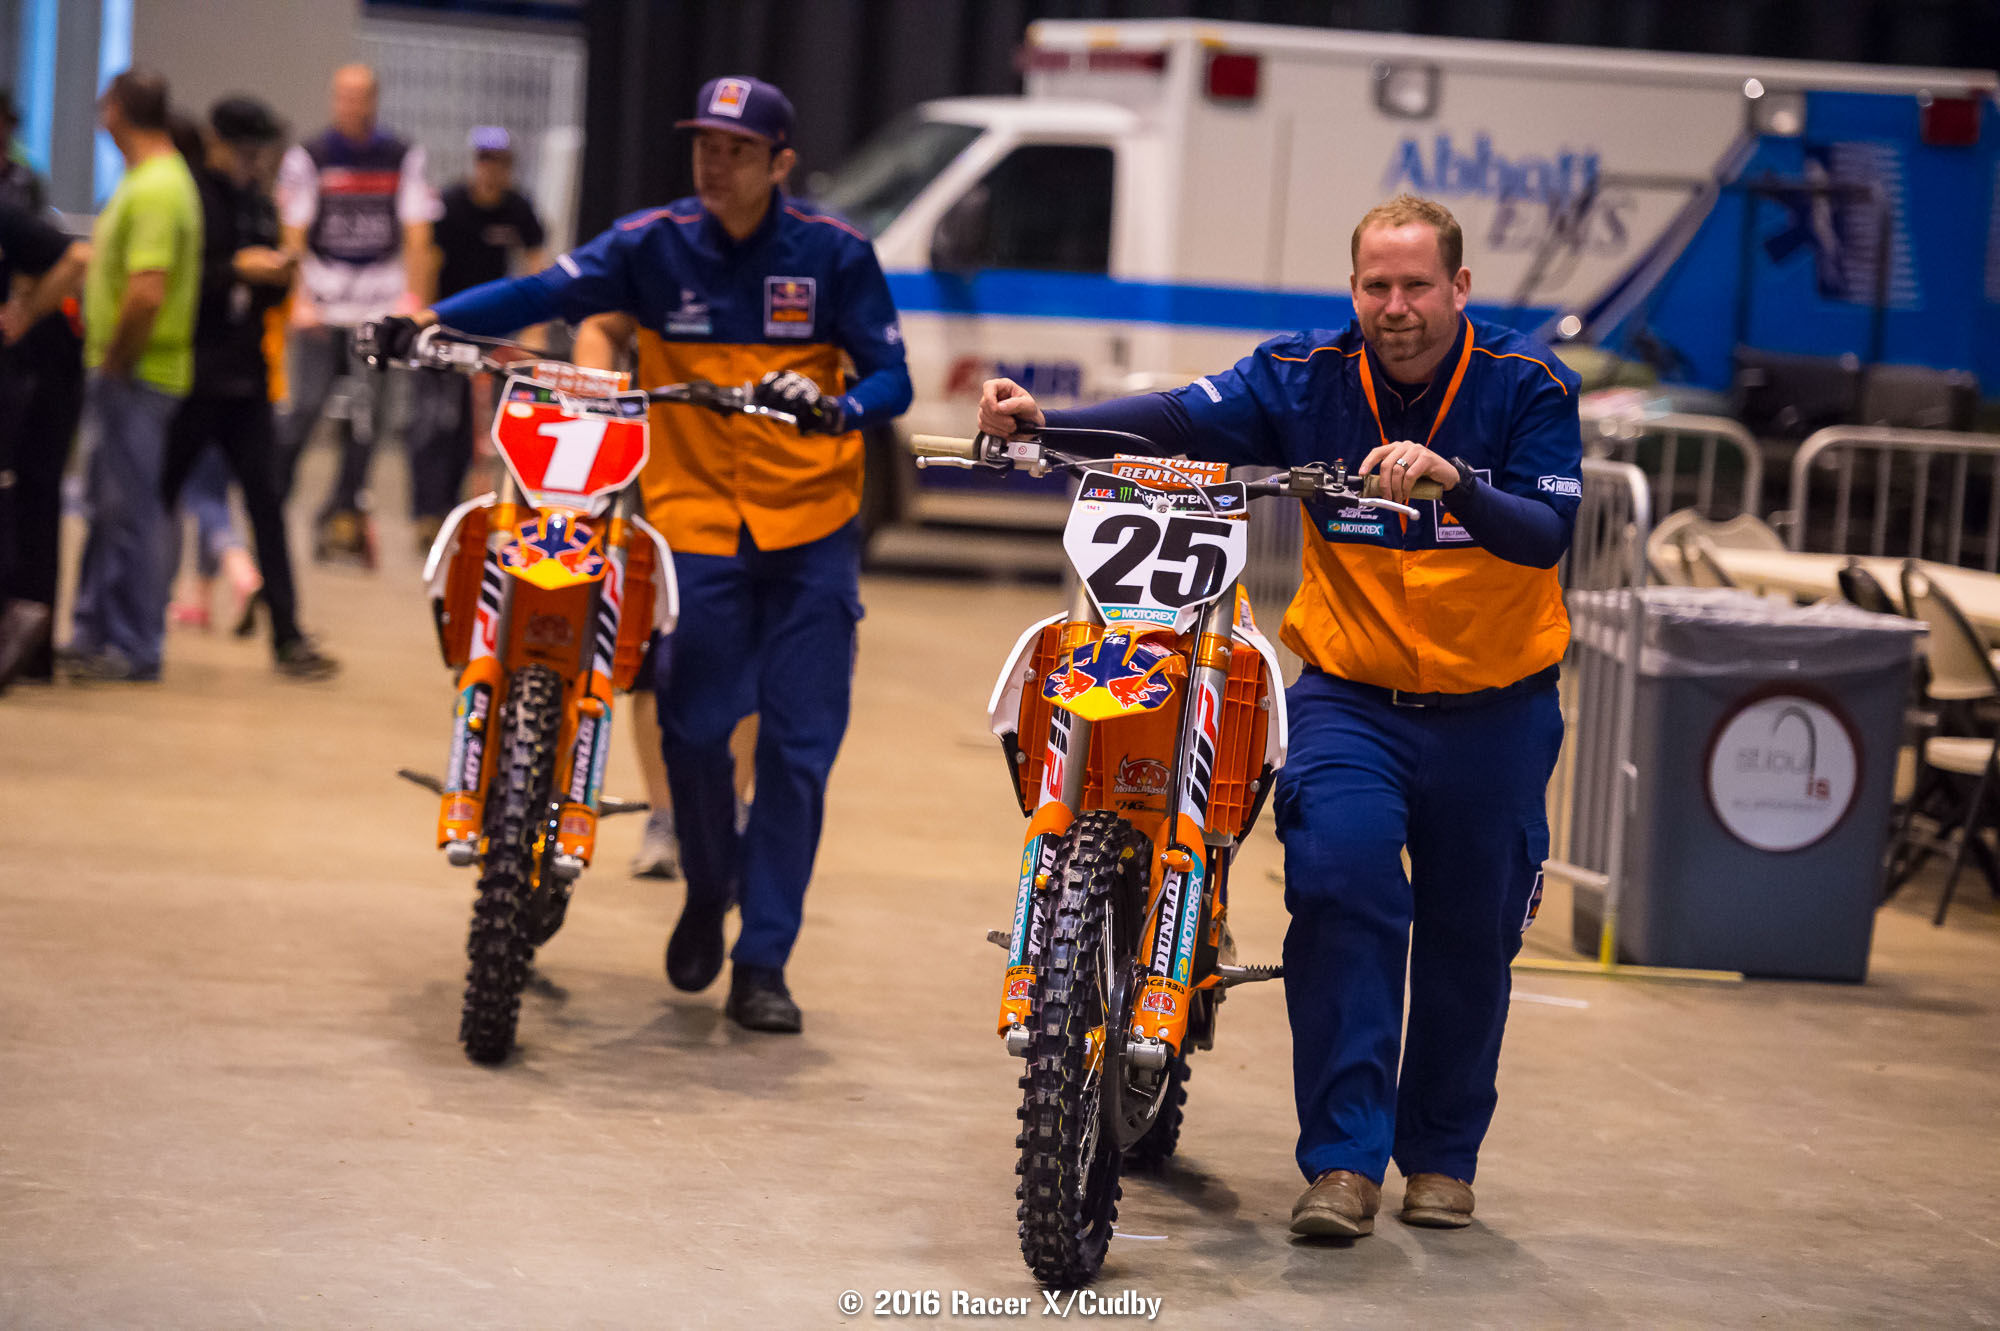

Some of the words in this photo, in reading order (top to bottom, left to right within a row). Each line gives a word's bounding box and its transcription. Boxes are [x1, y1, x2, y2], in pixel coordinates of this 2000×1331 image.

[537, 418, 608, 492] 1
[1117, 465, 1217, 487] RENTHAL
[1086, 514, 1233, 609] 25
[1341, 523, 1382, 535] MOTOREX
[1121, 609, 1175, 622] MOTOREX
[1008, 876, 1029, 965] MOTOREX
[1180, 872, 1202, 957] MOTOREX
